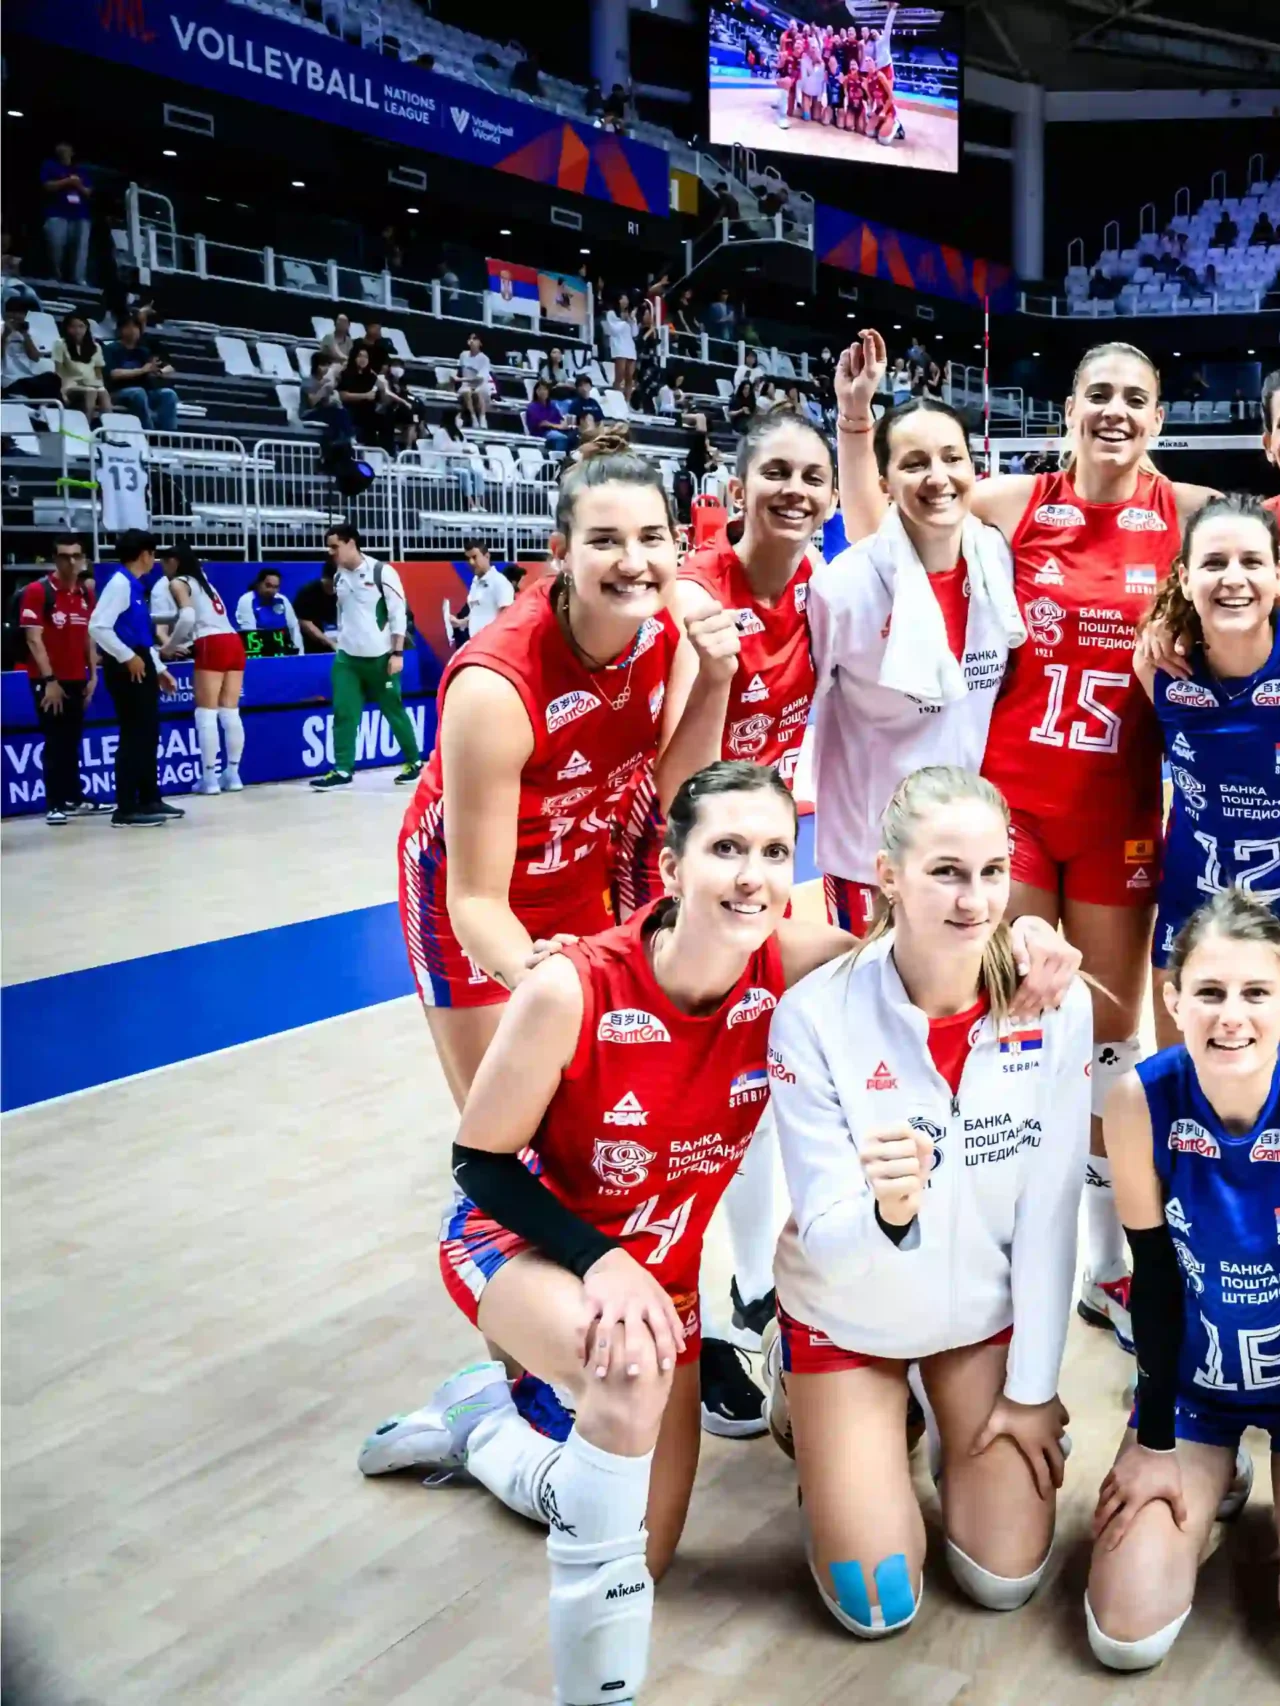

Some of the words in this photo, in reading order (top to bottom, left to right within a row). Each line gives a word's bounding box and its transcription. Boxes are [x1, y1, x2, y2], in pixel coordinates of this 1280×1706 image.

[170, 14, 380, 110] VOLLEYBALL
[384, 84, 436, 112] NATIONS
[384, 101, 430, 126] LEAGUE
[472, 114, 515, 137] Volleyball
[472, 126, 501, 146] World
[628, 221, 640, 236] R1
[108, 464, 139, 492] 13
[1079, 607, 1124, 621] БАНКА
[965, 649, 999, 664] БАНКА
[782, 694, 809, 717] БАНКА
[1029, 663, 1132, 754] 15
[1219, 783, 1268, 796] БАНКА
[609, 1012, 651, 1026] 百岁山
[1002, 1060, 1040, 1073] SERBIA
[865, 1078, 899, 1090] PEAK
[602, 1110, 651, 1127] PEAK
[963, 1112, 1012, 1132] БАНКА
[1176, 1121, 1205, 1138] 百岁山
[669, 1132, 723, 1153] БАНКА
[597, 1185, 630, 1195] 1921
[619, 1192, 698, 1265] 4
[1219, 1260, 1275, 1276] БАНКА
